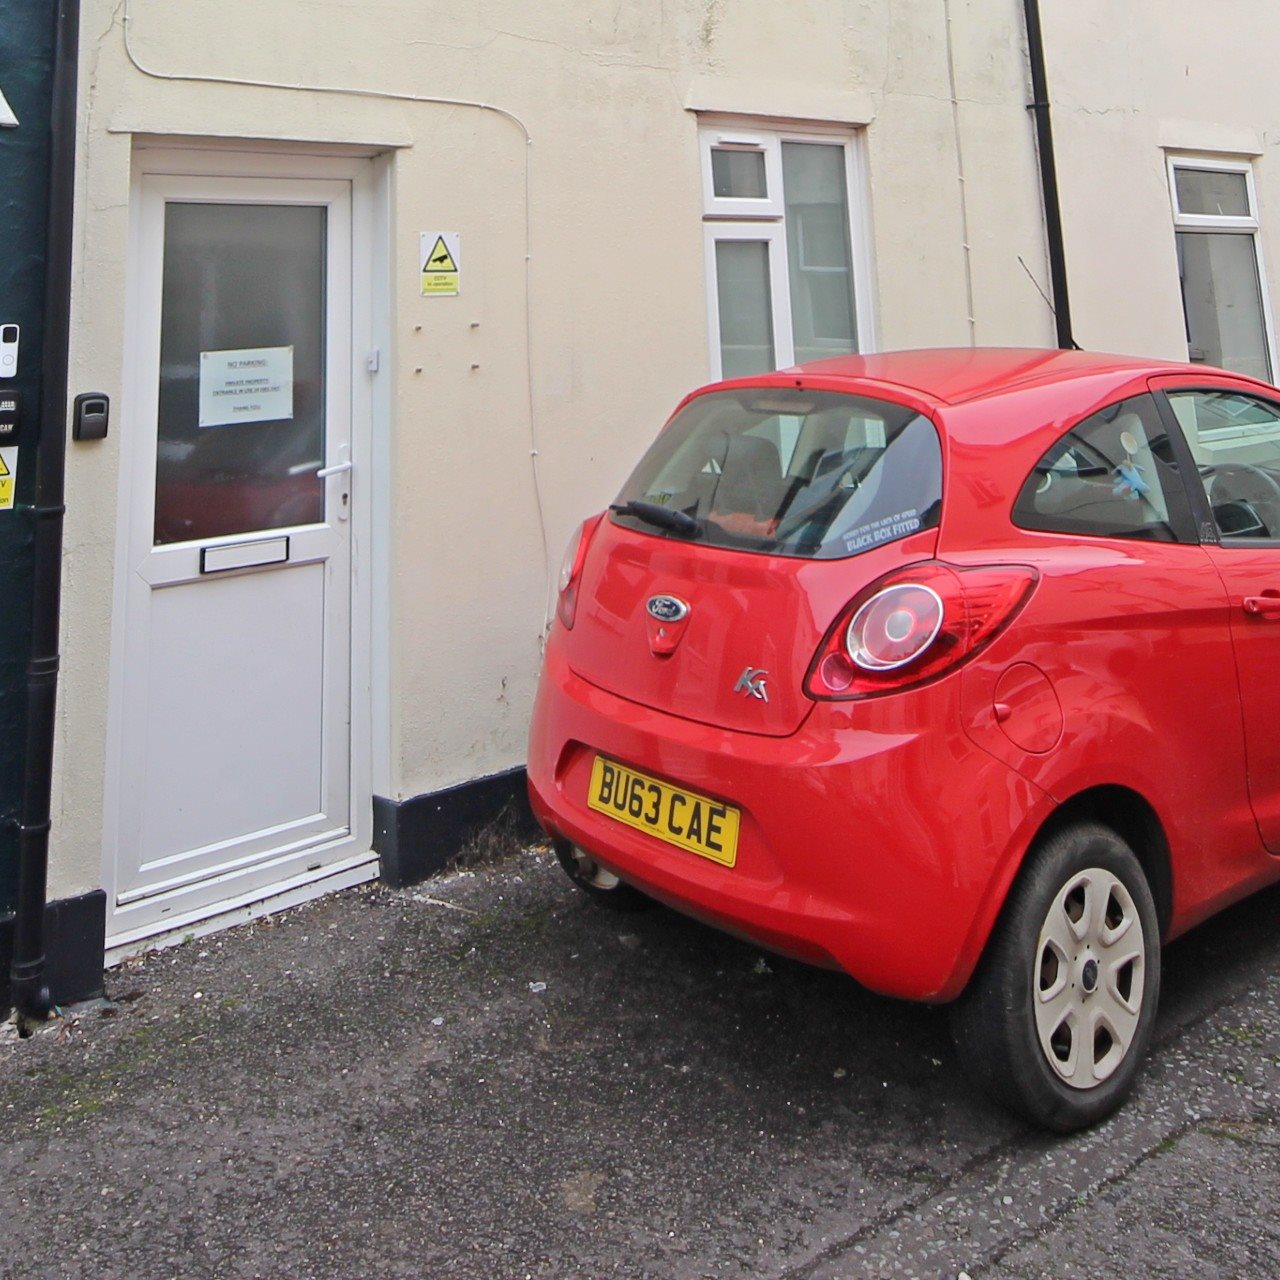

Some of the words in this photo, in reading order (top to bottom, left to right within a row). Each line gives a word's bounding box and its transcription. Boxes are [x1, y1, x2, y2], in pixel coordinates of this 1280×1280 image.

[846, 533, 874, 552] BLACK
[873, 526, 893, 541] BOX
[892, 518, 920, 535] FITTED
[597, 764, 663, 825] BU63
[667, 792, 728, 853] CAE
